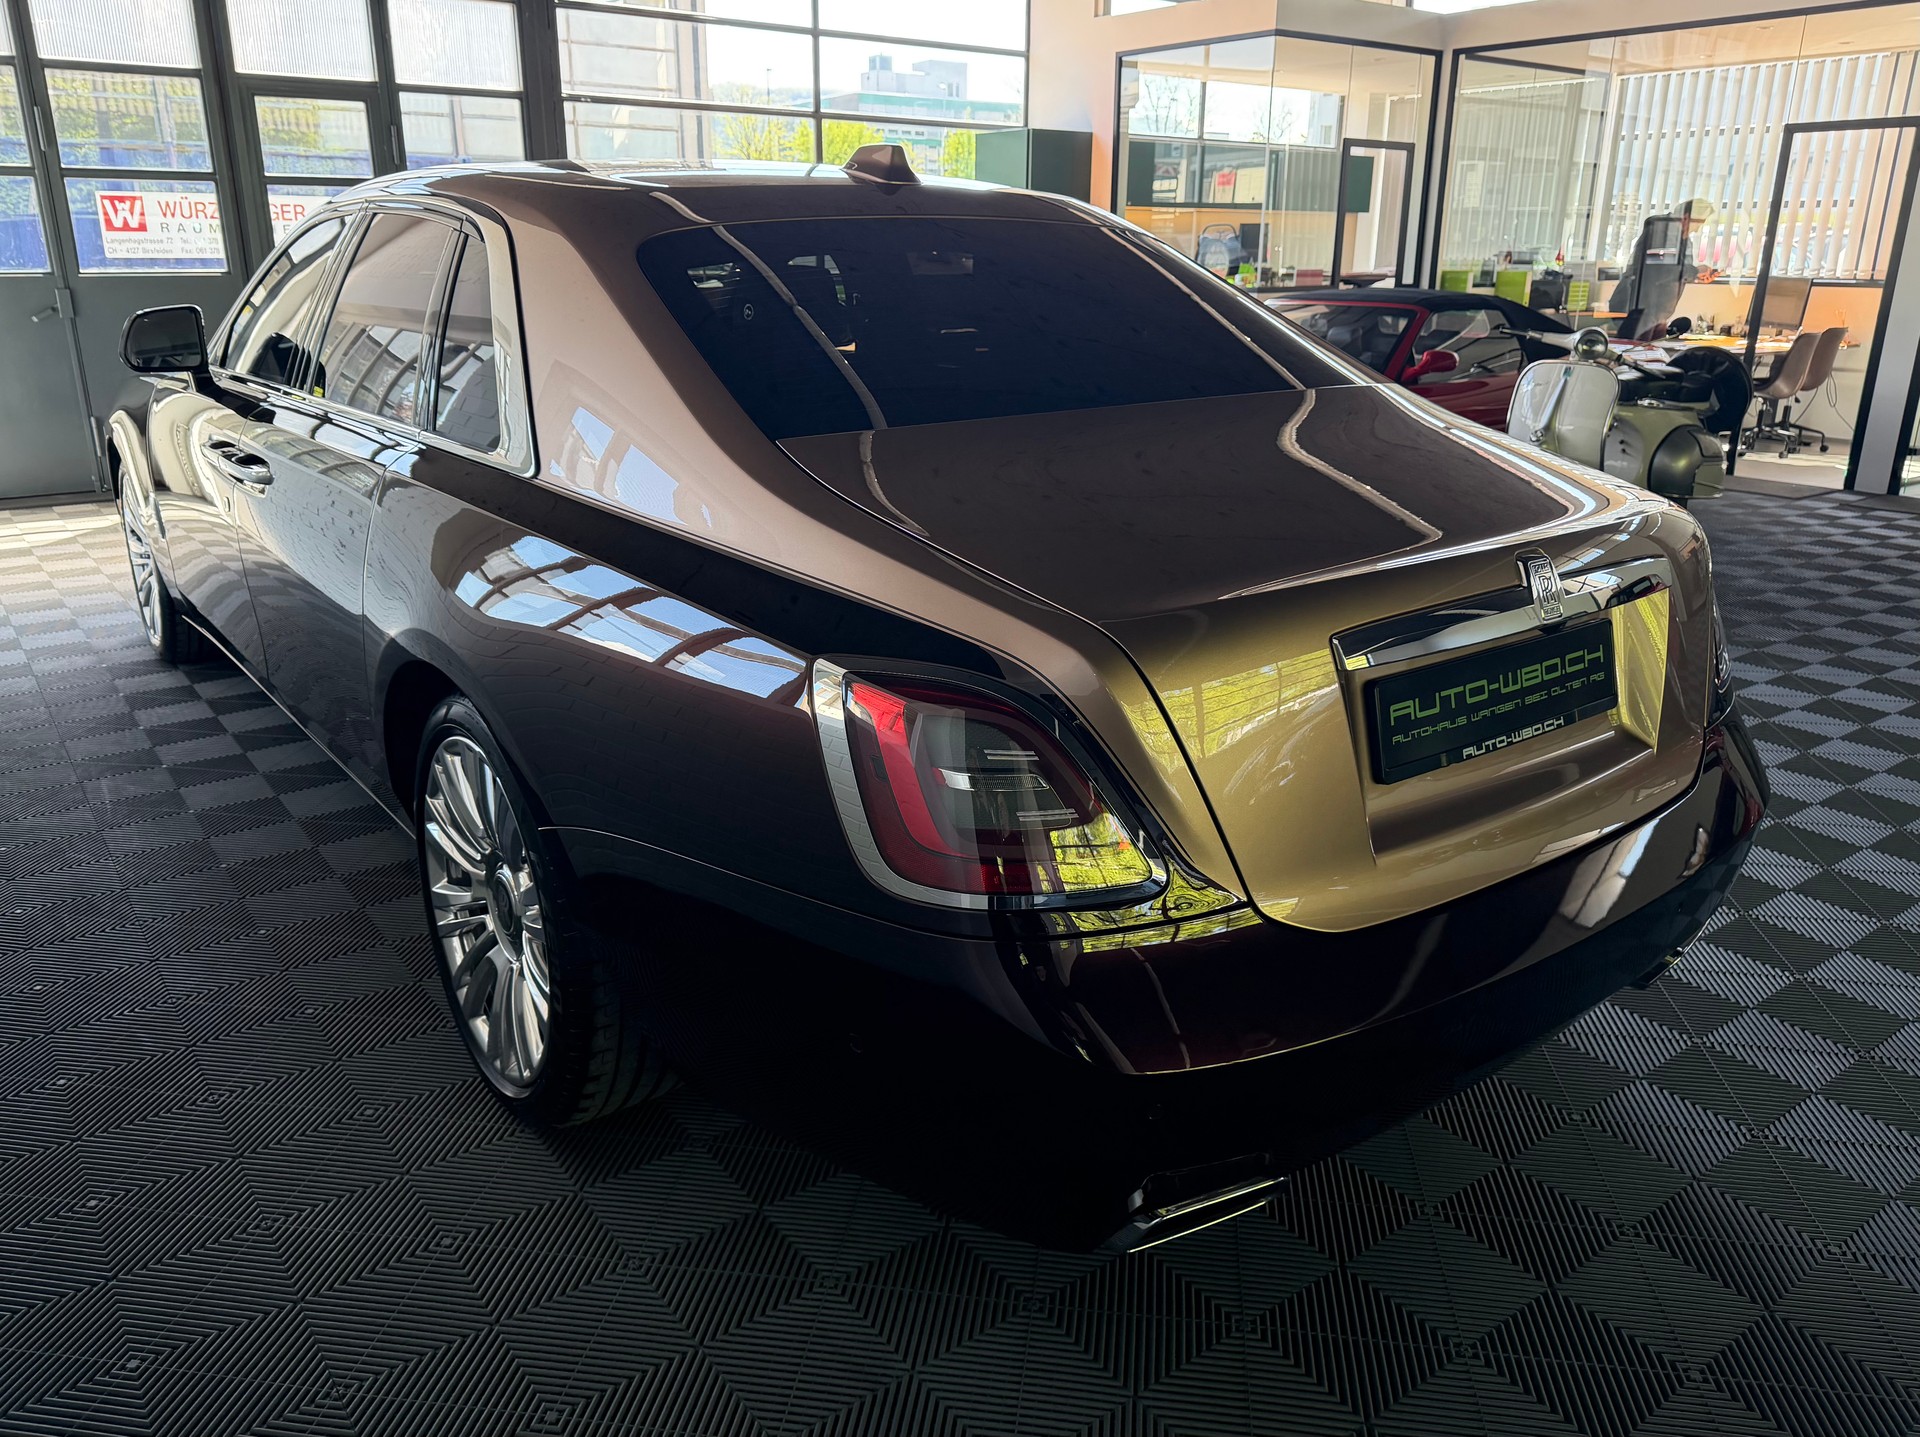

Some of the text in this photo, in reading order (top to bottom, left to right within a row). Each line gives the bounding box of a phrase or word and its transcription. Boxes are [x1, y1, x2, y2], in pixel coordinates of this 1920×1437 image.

[1392, 671, 1605, 745] AUTOHAUS WANGEN BEI OLTEN AG
